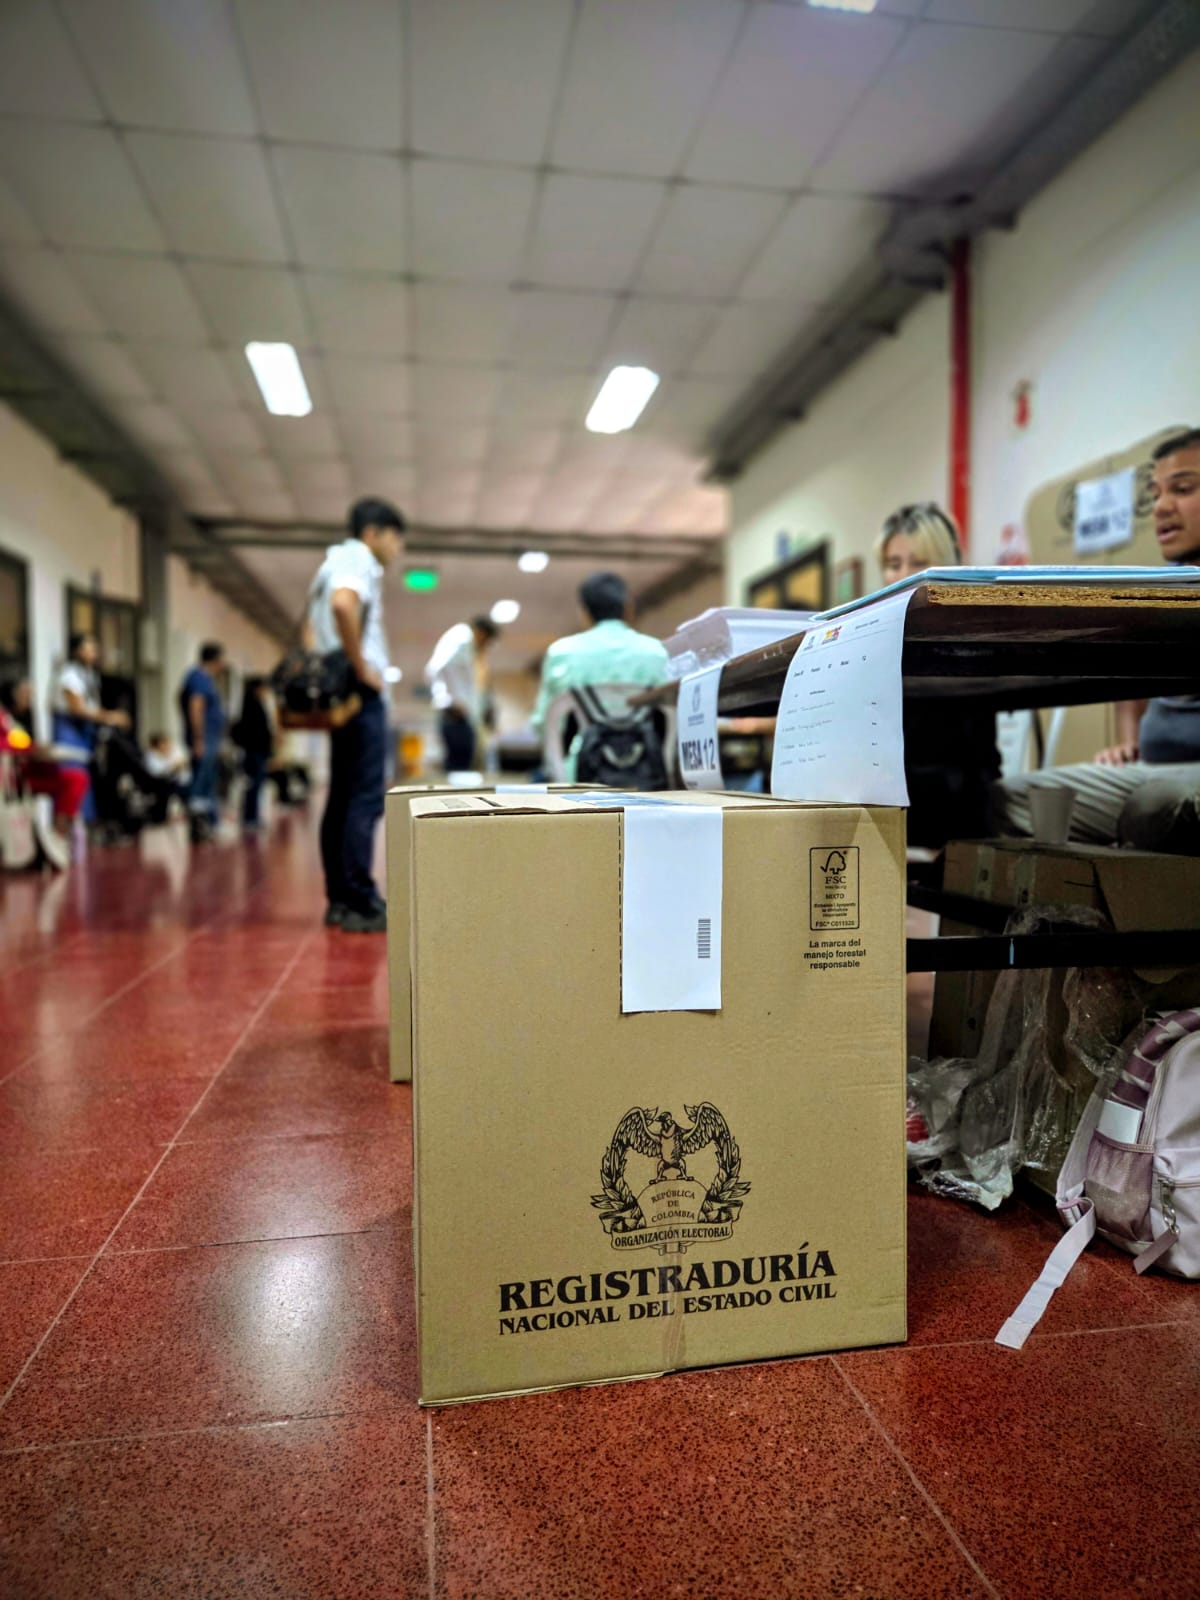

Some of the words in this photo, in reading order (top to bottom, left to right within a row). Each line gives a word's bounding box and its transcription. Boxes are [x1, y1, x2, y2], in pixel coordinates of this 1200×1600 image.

[681, 739, 704, 771] MESA
[703, 737, 716, 770] 12
[825, 875, 847, 885] FSC
[809, 940, 820, 949] La
[821, 940, 847, 948] marca
[848, 938, 861, 947] del
[803, 950, 834, 960] manejo
[835, 949, 866, 958] forestal
[810, 960, 860, 971] responsable
[651, 1189, 696, 1204] REPÚBLICA
[667, 1200, 680, 1208] DE
[651, 1209, 695, 1223] COLOMBIA
[614, 1226, 680, 1248] ORGANIZACIÓN
[681, 1226, 731, 1239] ELECTORAL
[498, 1241, 838, 1313] REGISTRADURÍA
[498, 1305, 622, 1336] NACIONAL
[628, 1299, 675, 1321] DEL
[683, 1289, 773, 1315] ESTADO
[778, 1282, 838, 1304] CIVIL
